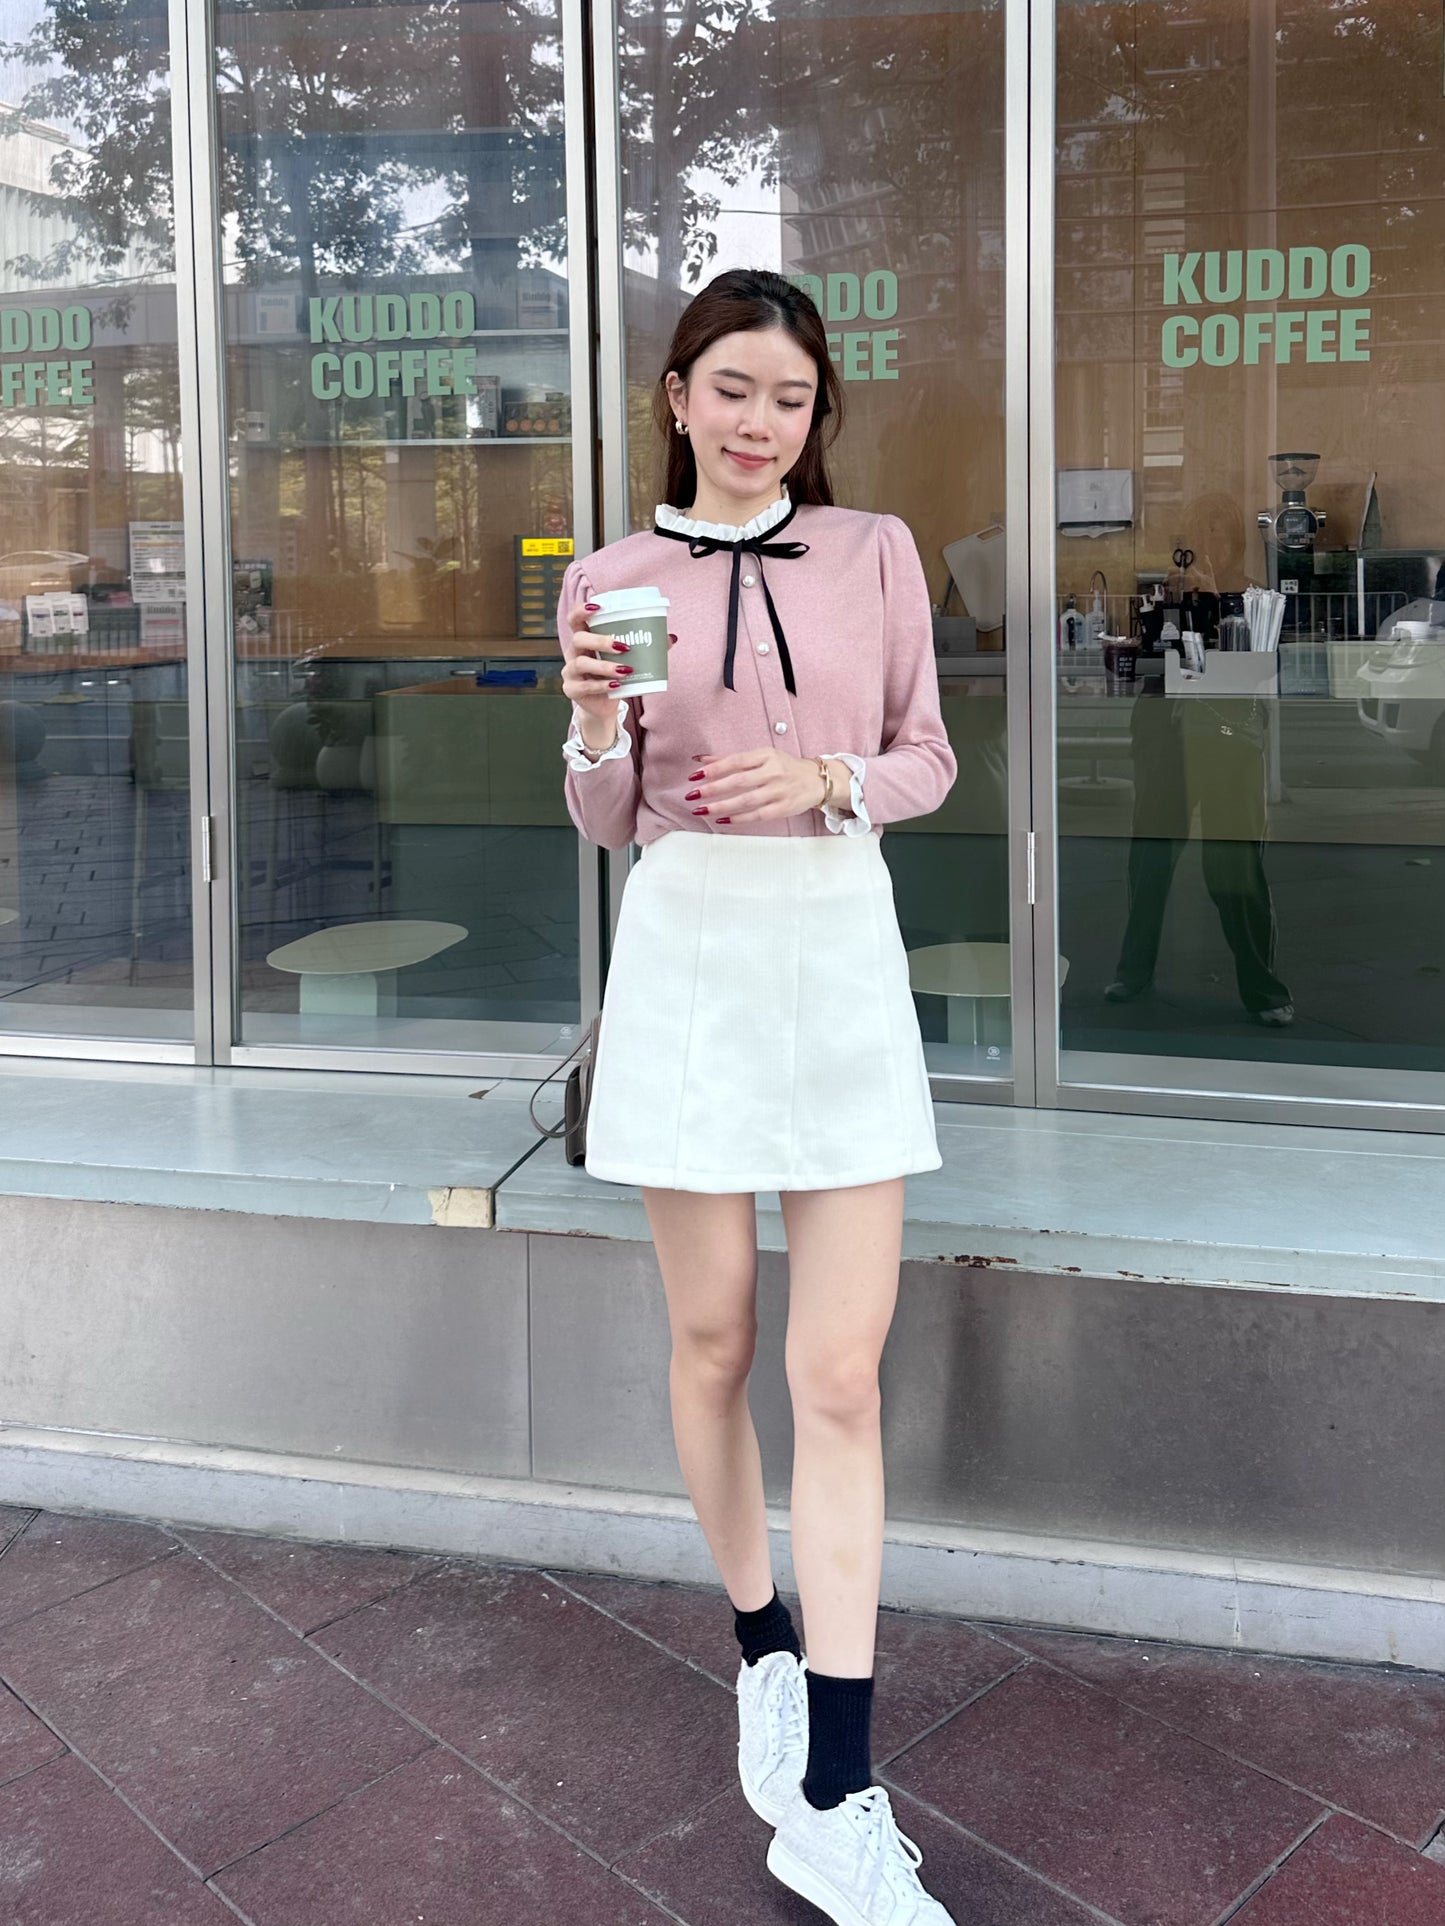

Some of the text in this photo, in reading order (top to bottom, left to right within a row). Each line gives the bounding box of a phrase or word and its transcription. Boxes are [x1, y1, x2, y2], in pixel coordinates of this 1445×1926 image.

[1163, 243, 1371, 305] KUDDO
[308, 290, 476, 344] KUDDO
[1161, 308, 1372, 368] COFFEE
[310, 347, 478, 400] COFFEE
